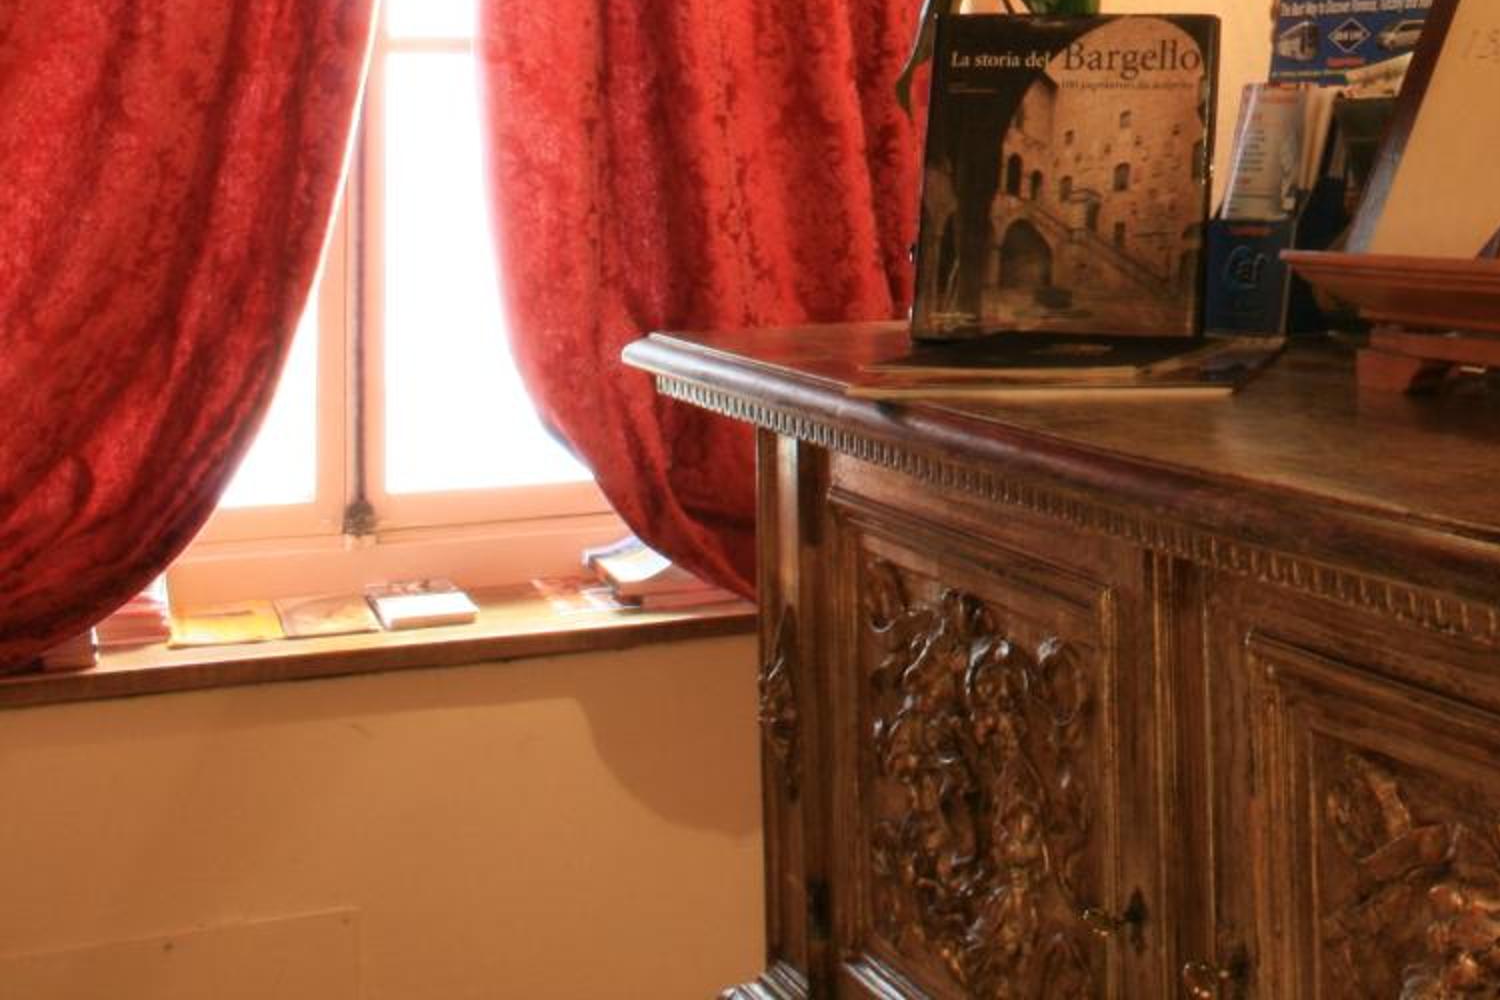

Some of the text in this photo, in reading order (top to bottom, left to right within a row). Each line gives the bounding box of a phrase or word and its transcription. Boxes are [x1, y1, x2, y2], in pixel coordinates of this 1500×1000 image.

[951, 39, 1201, 81] La storia del Bargello
